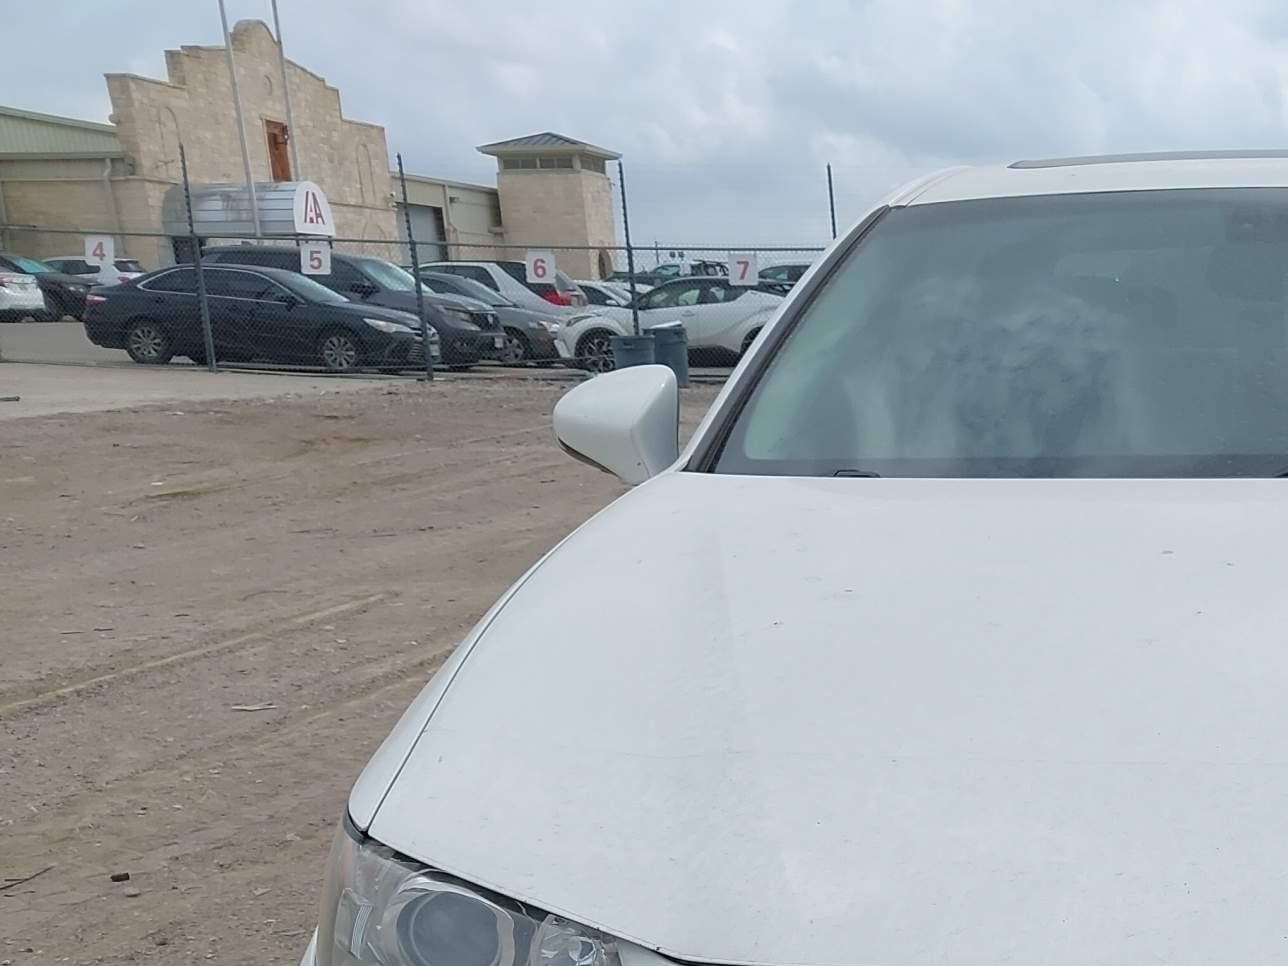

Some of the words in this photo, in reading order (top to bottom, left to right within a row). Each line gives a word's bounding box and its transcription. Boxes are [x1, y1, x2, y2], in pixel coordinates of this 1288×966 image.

[92, 241, 106, 261] 4
[309, 250, 322, 270] 5
[533, 258, 546, 278] 6
[736, 260, 750, 281] 7
